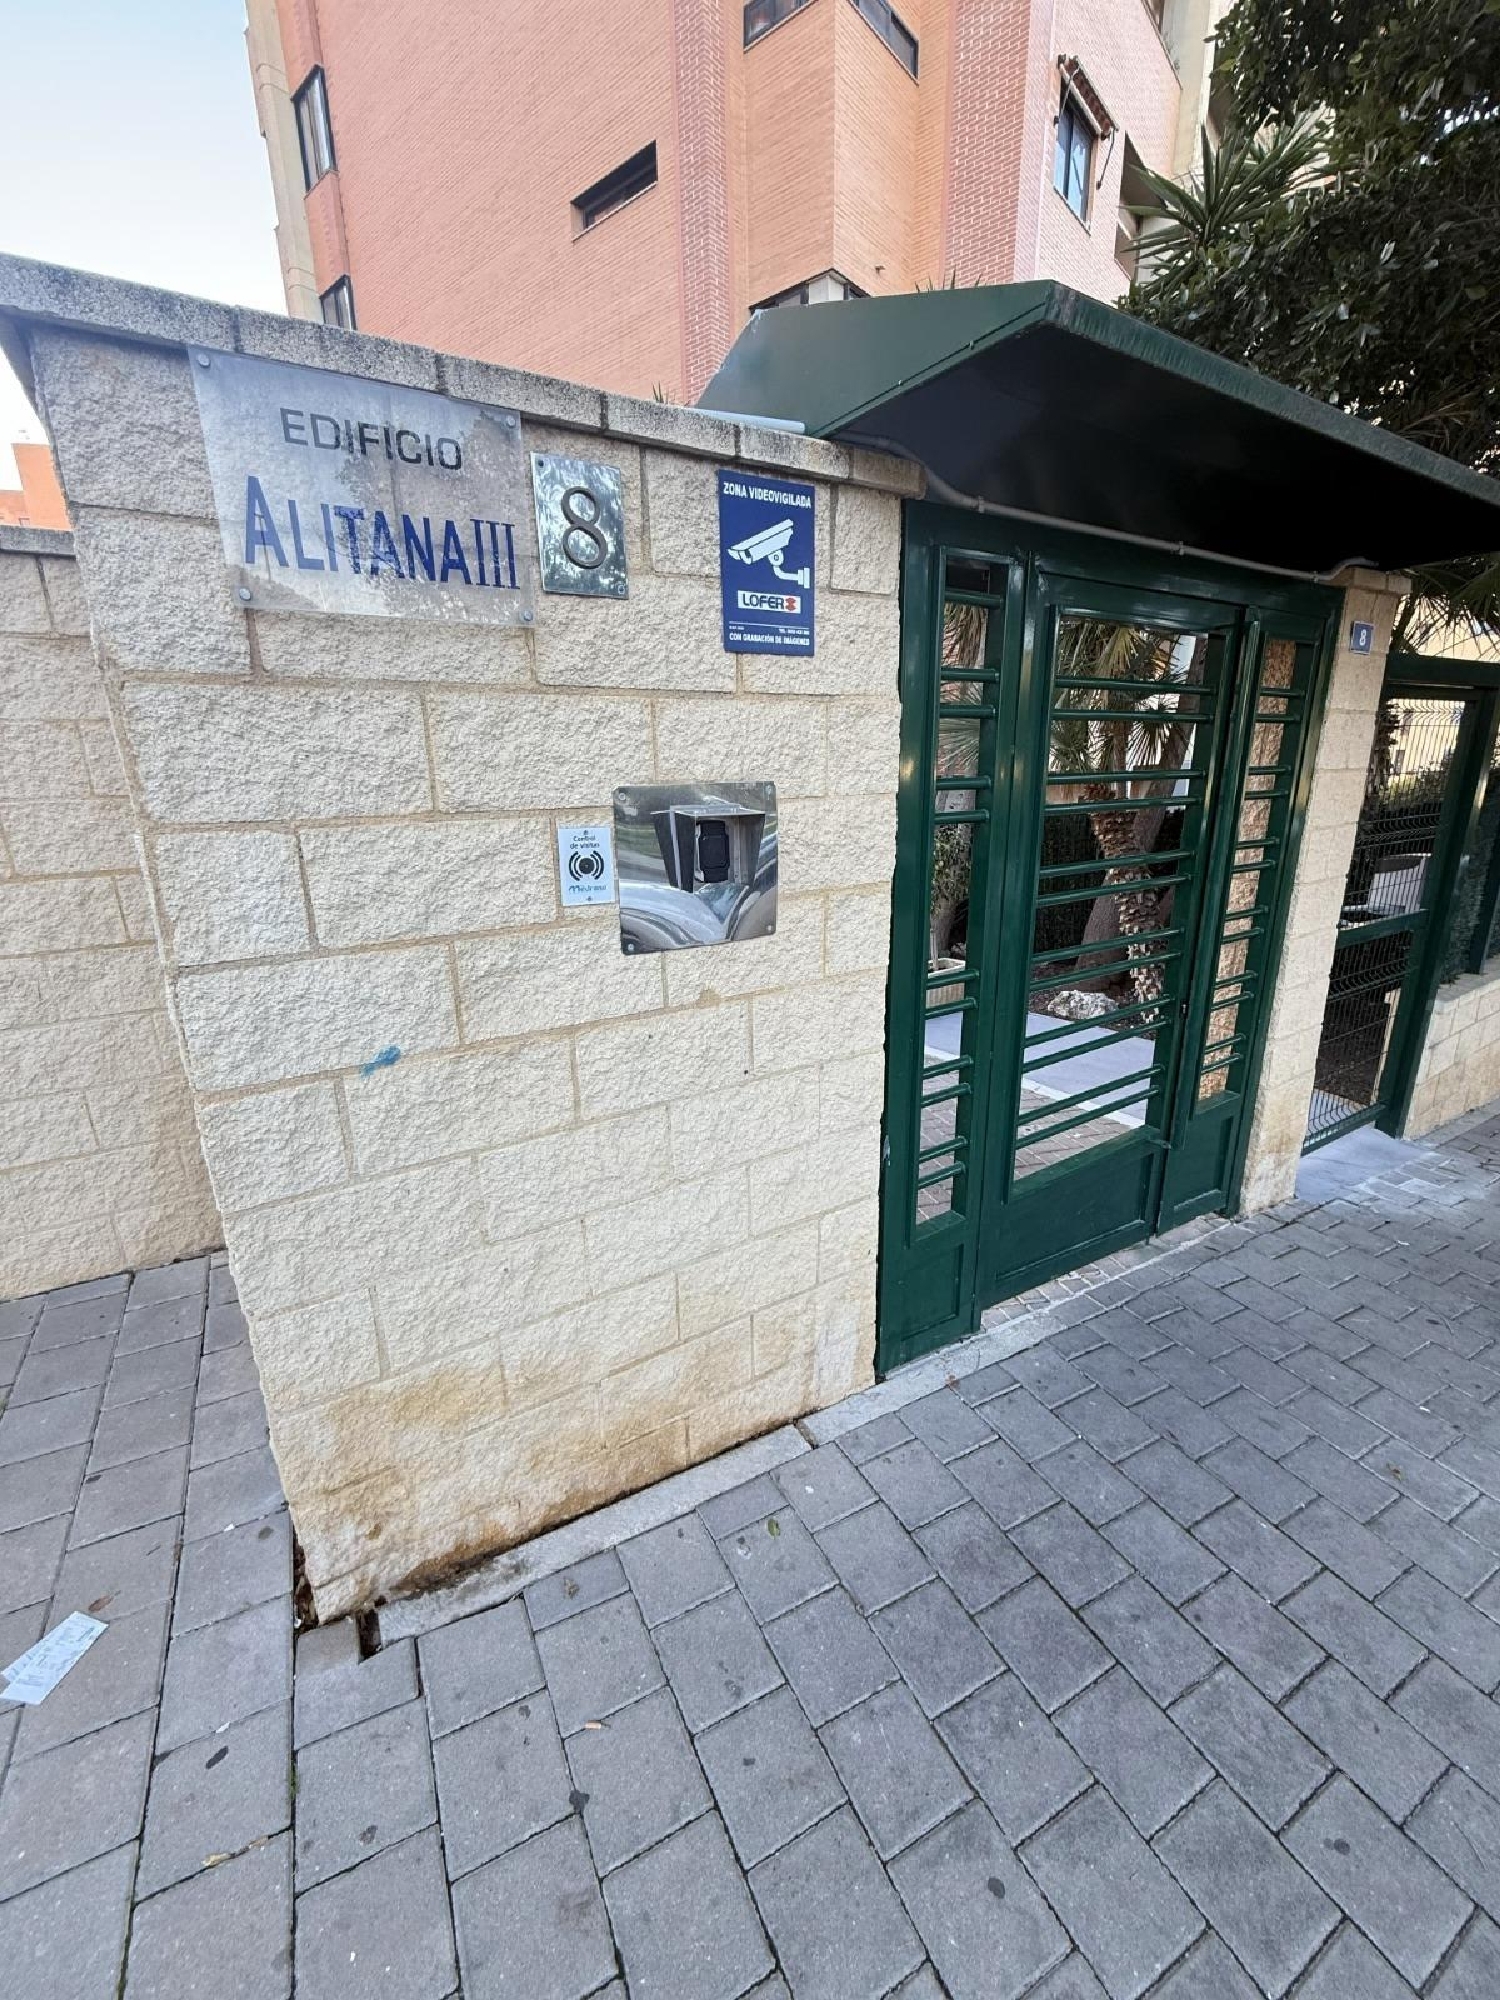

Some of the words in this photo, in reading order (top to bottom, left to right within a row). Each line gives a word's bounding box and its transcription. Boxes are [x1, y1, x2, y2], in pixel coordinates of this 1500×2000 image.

[280, 408, 462, 470] EDIFICIO
[723, 481, 747, 498] ZONA
[748, 486, 812, 509] VIDEOVIGILADA
[561, 487, 609, 570] 8
[742, 593, 785, 610] LOFER
[1359, 629, 1366, 645] 8
